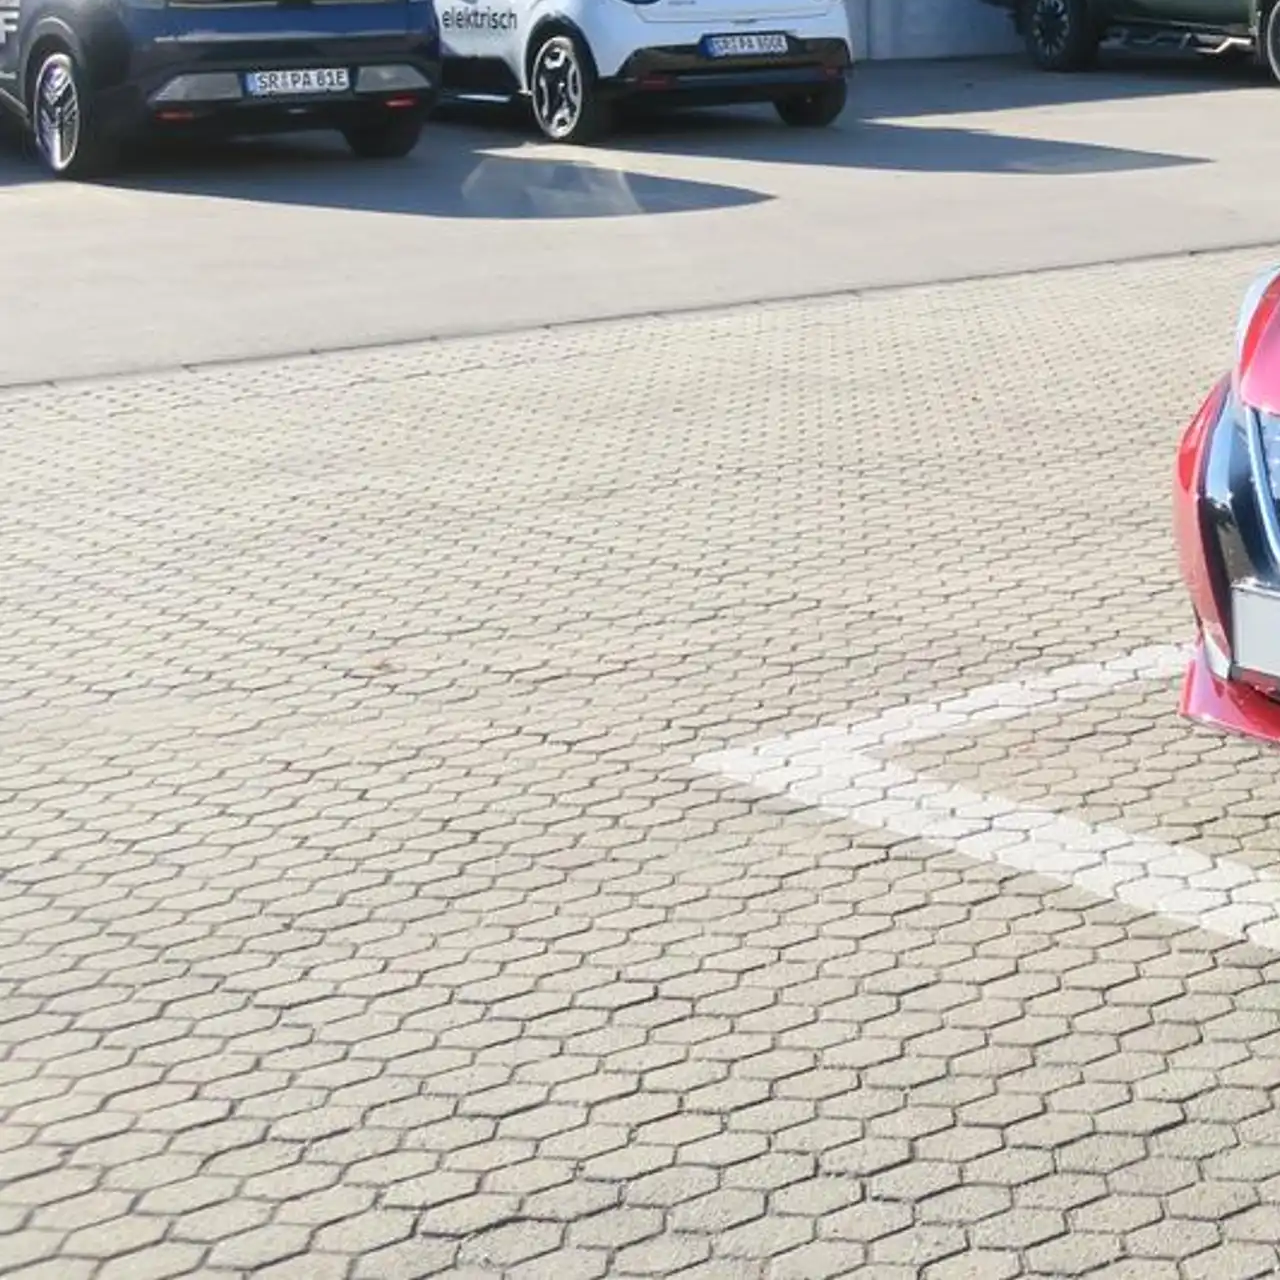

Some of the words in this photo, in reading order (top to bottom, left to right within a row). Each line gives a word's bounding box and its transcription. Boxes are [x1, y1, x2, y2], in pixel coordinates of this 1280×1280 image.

[442, 6, 518, 29] elektrisch
[258, 72, 280, 90] SR
[290, 72, 312, 88] PA
